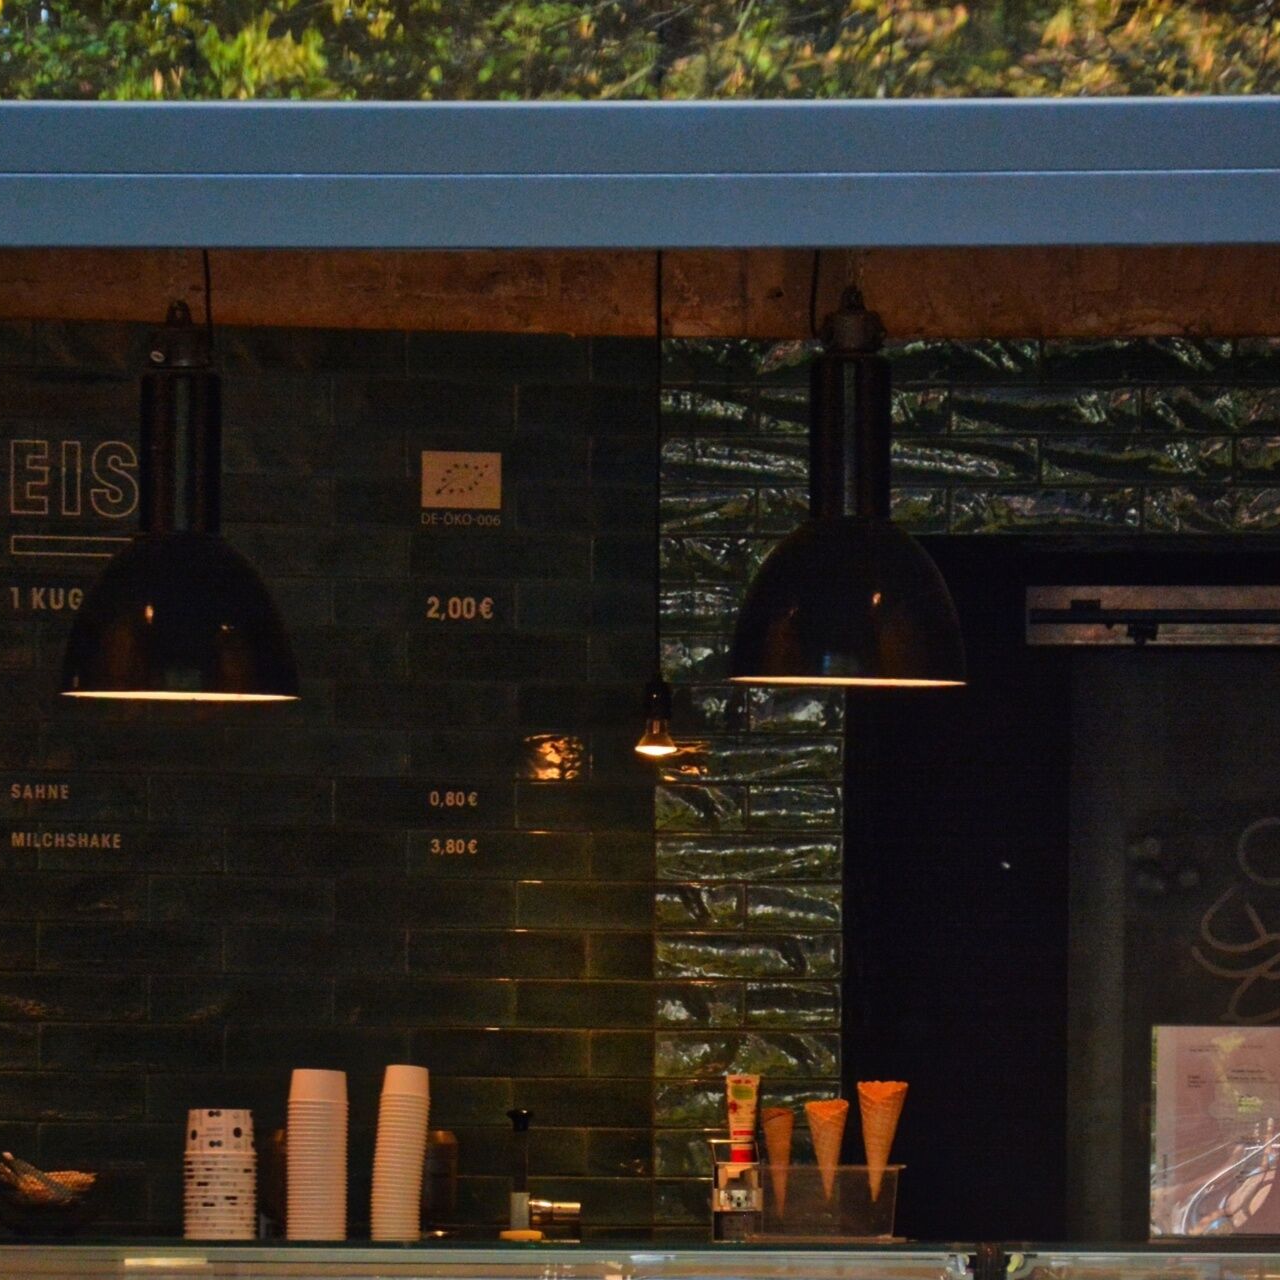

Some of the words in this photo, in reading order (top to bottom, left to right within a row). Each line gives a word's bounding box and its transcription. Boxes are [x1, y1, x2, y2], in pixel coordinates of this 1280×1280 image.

[10, 440, 138, 518] EIS
[10, 587, 20, 609] 1
[427, 596, 494, 620] 2,00€
[11, 784, 69, 800] SAHNE
[429, 791, 477, 807] 0,80€
[11, 832, 121, 850] MILCHSHAKE
[431, 839, 477, 855] 3,80€
